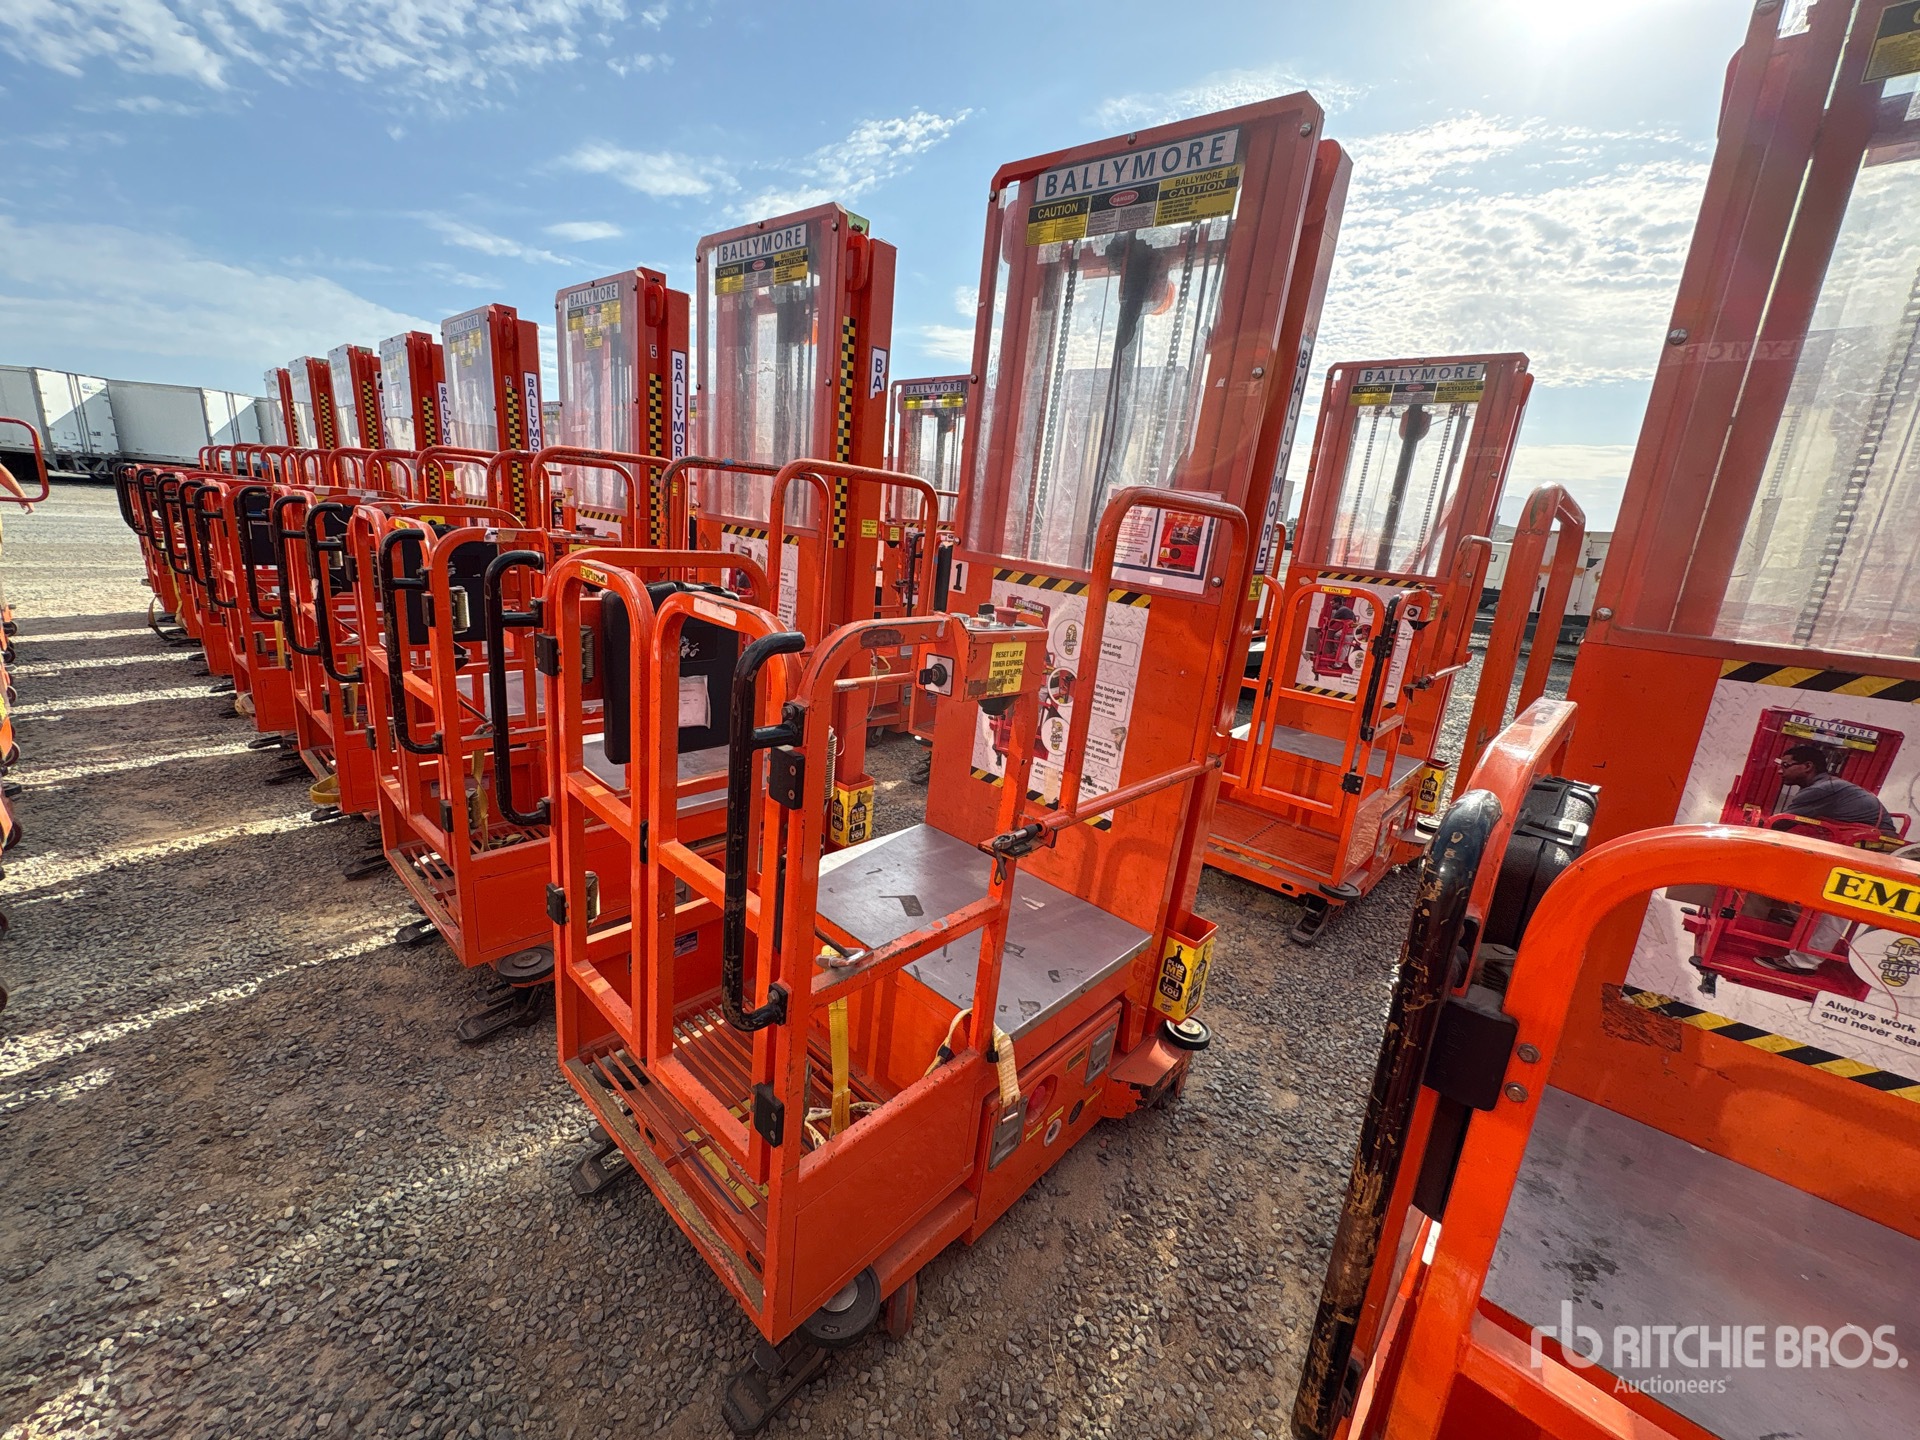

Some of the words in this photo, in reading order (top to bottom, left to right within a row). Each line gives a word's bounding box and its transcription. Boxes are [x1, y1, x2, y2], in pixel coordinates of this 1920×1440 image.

[1044, 135, 1227, 198] BALLYMORE
[1175, 171, 1223, 187] BALLYMORE
[1169, 180, 1227, 198] CAUTION
[1037, 202, 1079, 220] CAUTION
[722, 227, 802, 261] BALLYMORE
[720, 266, 739, 276] CAUTION
[570, 284, 616, 307] BALLYMORE
[651, 345, 657, 358] 5
[506, 376, 511, 386] 2
[873, 358, 883, 390] BA
[1364, 366, 1477, 382] BALLYMORE
[906, 383, 961, 394] BALLYMORE
[673, 358, 684, 459] BALLYMOR
[1257, 350, 1308, 564] BALLYMORE
[953, 563, 963, 591] 1
[1104, 686, 1115, 694] body
[1103, 700, 1115, 708] hook
[1794, 716, 1875, 738] BALLYMORE
[1095, 747, 1116, 757] attached
[850, 829, 864, 839] YOU
[1166, 964, 1184, 977] ME
[1167, 959, 1185, 971] PLUG
[1878, 961, 1920, 975] GEAR
[1887, 970, 1909, 980] UP
[1162, 984, 1180, 998] YOU
[1820, 1010, 1848, 1025] and
[1849, 1018, 1892, 1038] never
[1824, 999, 1877, 1023] Always
[1880, 1017, 1917, 1034] work
